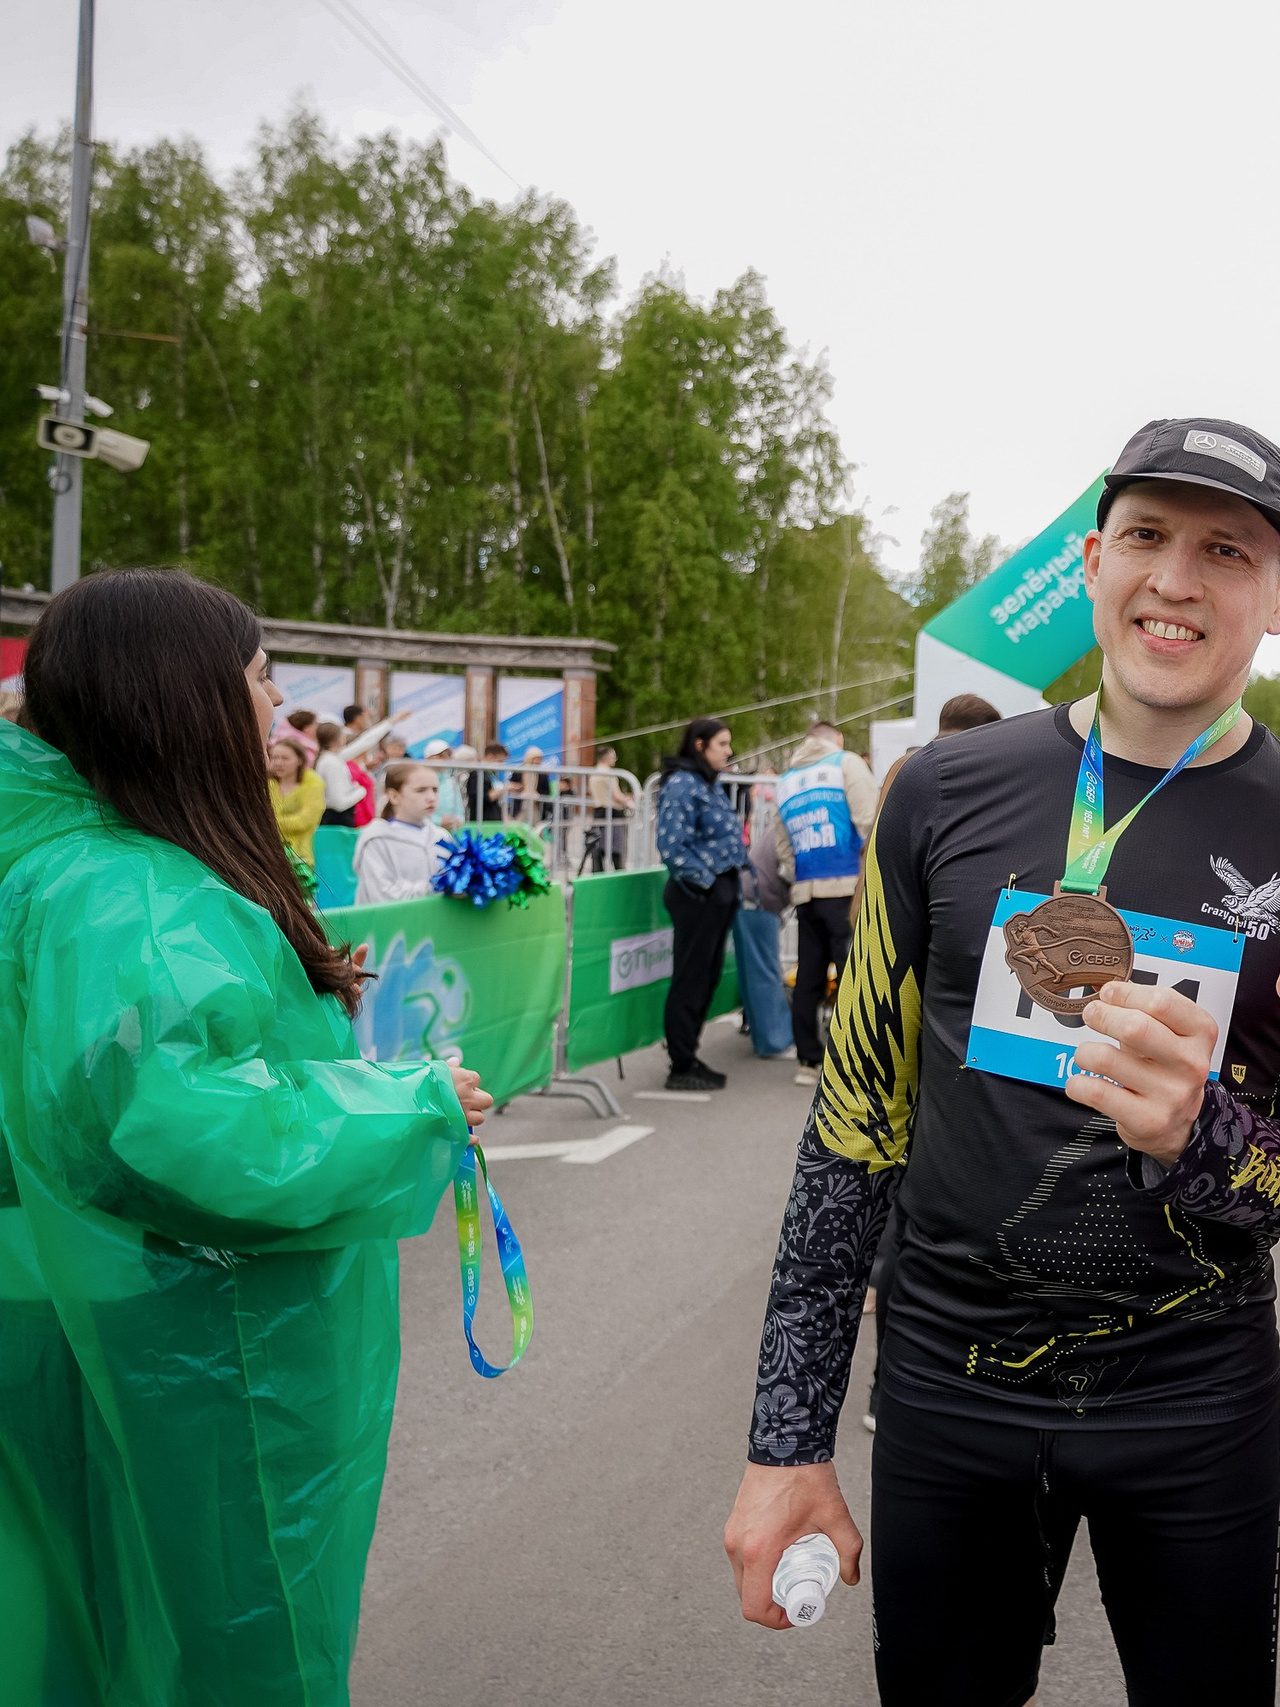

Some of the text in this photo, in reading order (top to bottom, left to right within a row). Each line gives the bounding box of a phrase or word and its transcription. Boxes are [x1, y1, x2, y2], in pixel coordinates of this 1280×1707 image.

[989, 531, 1084, 625] зелёный
[1085, 782, 1098, 803] СБЕР
[1086, 953, 1121, 967] СБЕР
